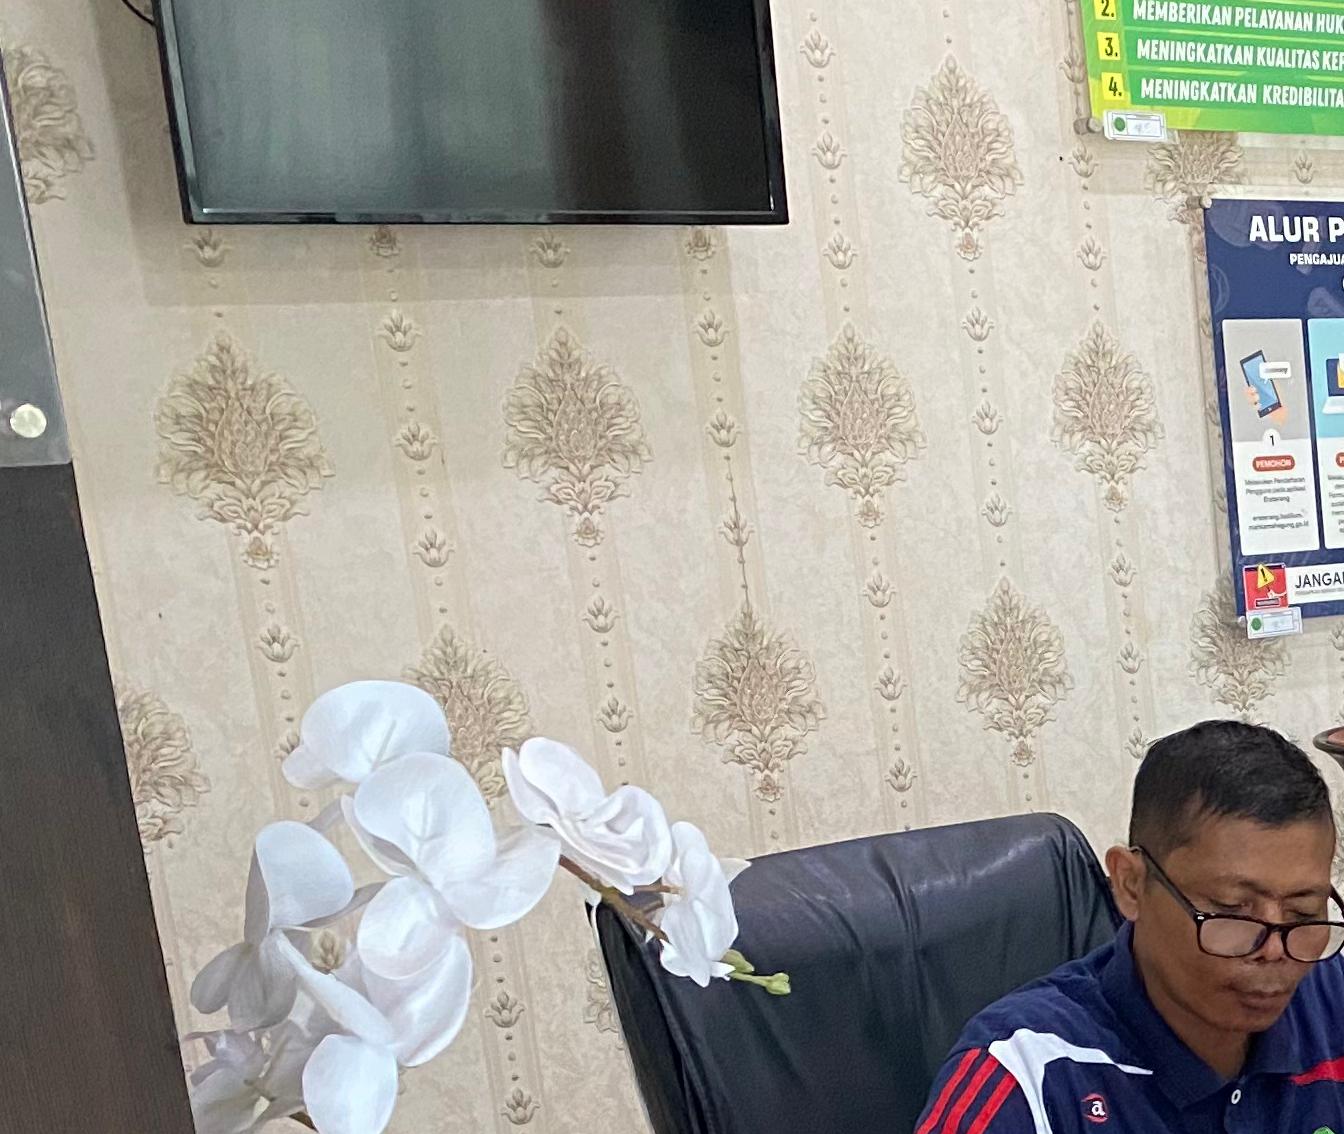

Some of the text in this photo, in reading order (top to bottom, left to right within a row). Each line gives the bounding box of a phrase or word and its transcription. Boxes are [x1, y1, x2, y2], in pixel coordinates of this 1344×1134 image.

[1133, 0, 1232, 26] MEMBERIKAN
[1235, 6, 1313, 32] PELAYANAN
[1104, 37, 1118, 57] 3.
[1137, 38, 1253, 65] MENINGKATKAN
[1256, 46, 1319, 70] KUALITAS
[1108, 76, 1122, 97] 4.
[1141, 78, 1257, 104] MENINGKATKAN
[1250, 216, 1321, 243] ALUR
[1269, 435, 1275, 446] 1
